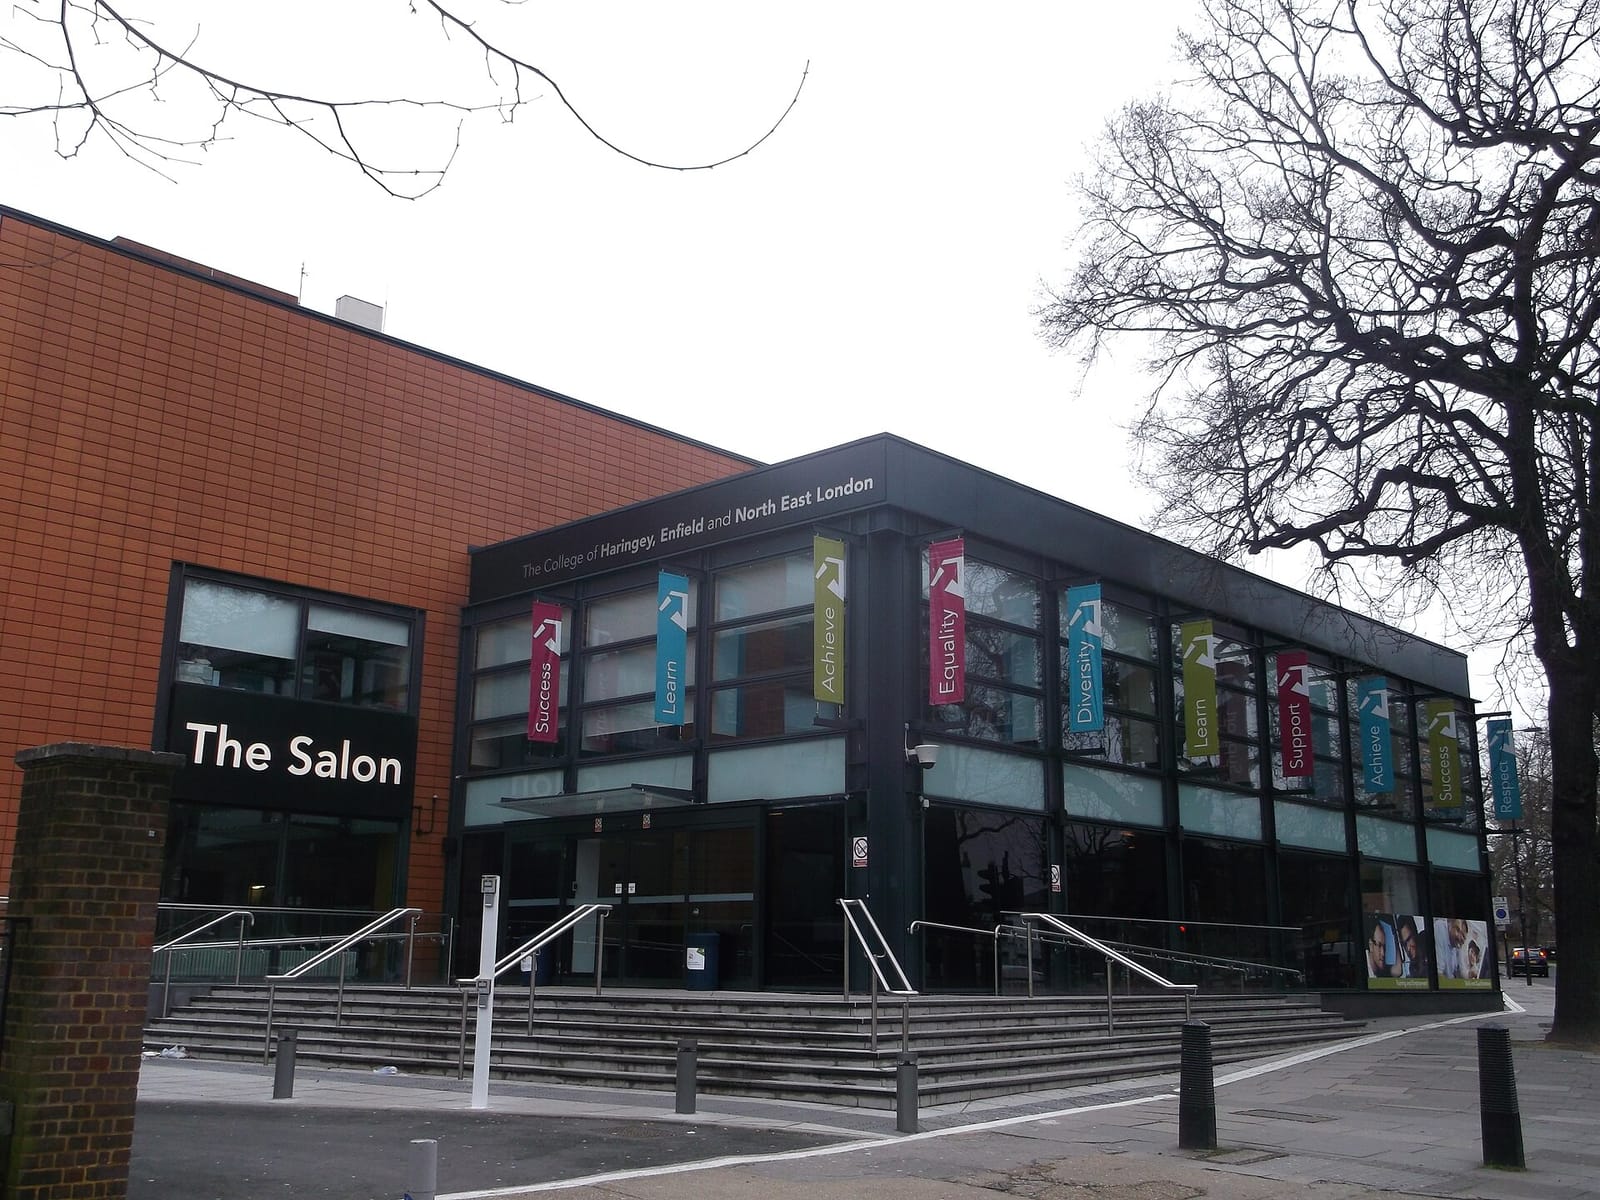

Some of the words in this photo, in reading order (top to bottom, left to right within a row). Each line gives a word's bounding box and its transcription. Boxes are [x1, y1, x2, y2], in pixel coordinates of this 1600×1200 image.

[522, 564, 542, 578] The
[543, 553, 584, 573] College
[586, 544, 599, 562] of
[600, 533, 656, 558] Haringey,
[660, 517, 704, 543] Enfield
[707, 510, 731, 530] and
[735, 499, 776, 523] North
[781, 491, 812, 512] East
[816, 477, 874, 503] London
[821, 607, 836, 694] Achieve
[938, 609, 959, 694] Equality
[1077, 641, 1096, 723] Diversity
[535, 662, 552, 733] Success
[662, 660, 678, 715] Learn
[186, 722, 272, 771] The
[287, 735, 402, 785] Salon
[1194, 699, 1208, 748] Learn
[1288, 703, 1307, 769] Support
[1368, 725, 1385, 786] Achieve
[1439, 745, 1453, 801] Success
[1500, 760, 1516, 813] Respect
